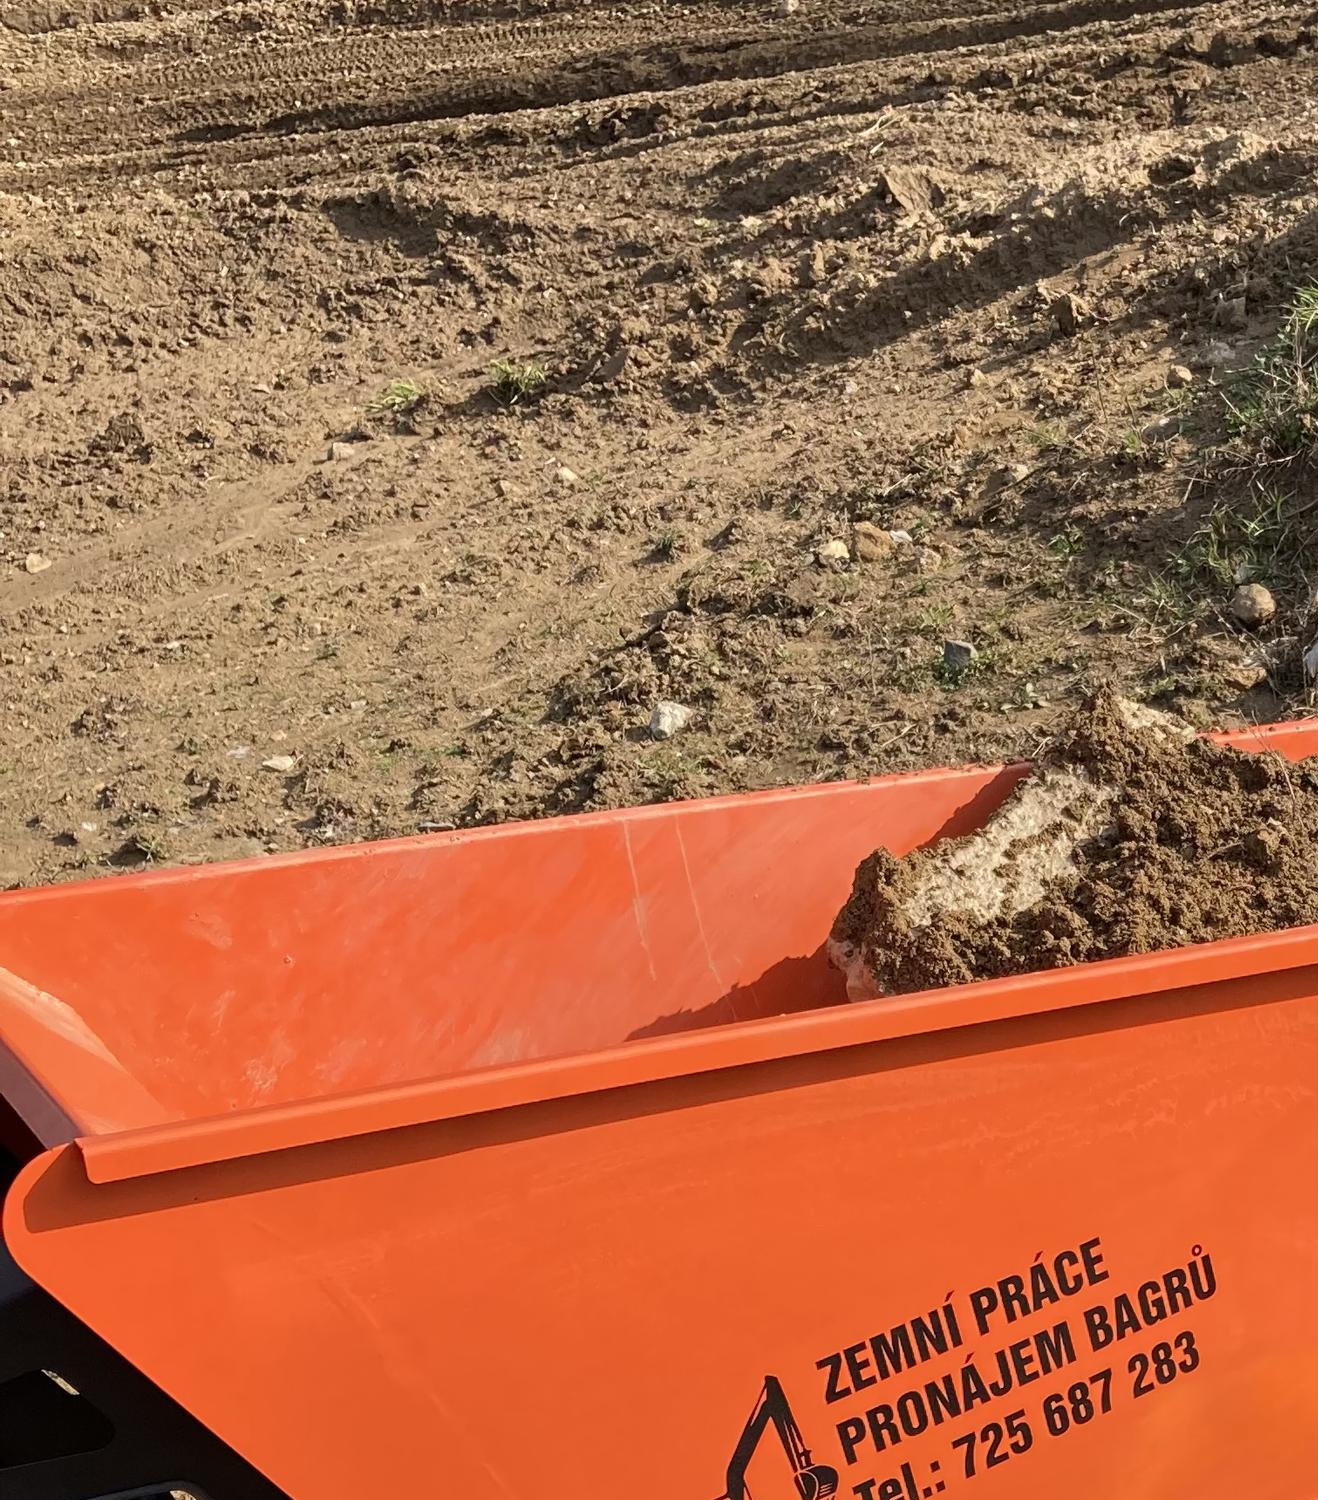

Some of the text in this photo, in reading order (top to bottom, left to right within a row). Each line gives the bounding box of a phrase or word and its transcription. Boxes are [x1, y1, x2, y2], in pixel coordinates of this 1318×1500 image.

[816, 1237, 1109, 1404] ZEMNÍ PRÁCE
[836, 1245, 1217, 1465] PRONÁJEM BAGRŮ
[952, 1409, 1034, 1478] 725
[1043, 1368, 1113, 1436] 687
[1128, 1331, 1200, 1398] 283
